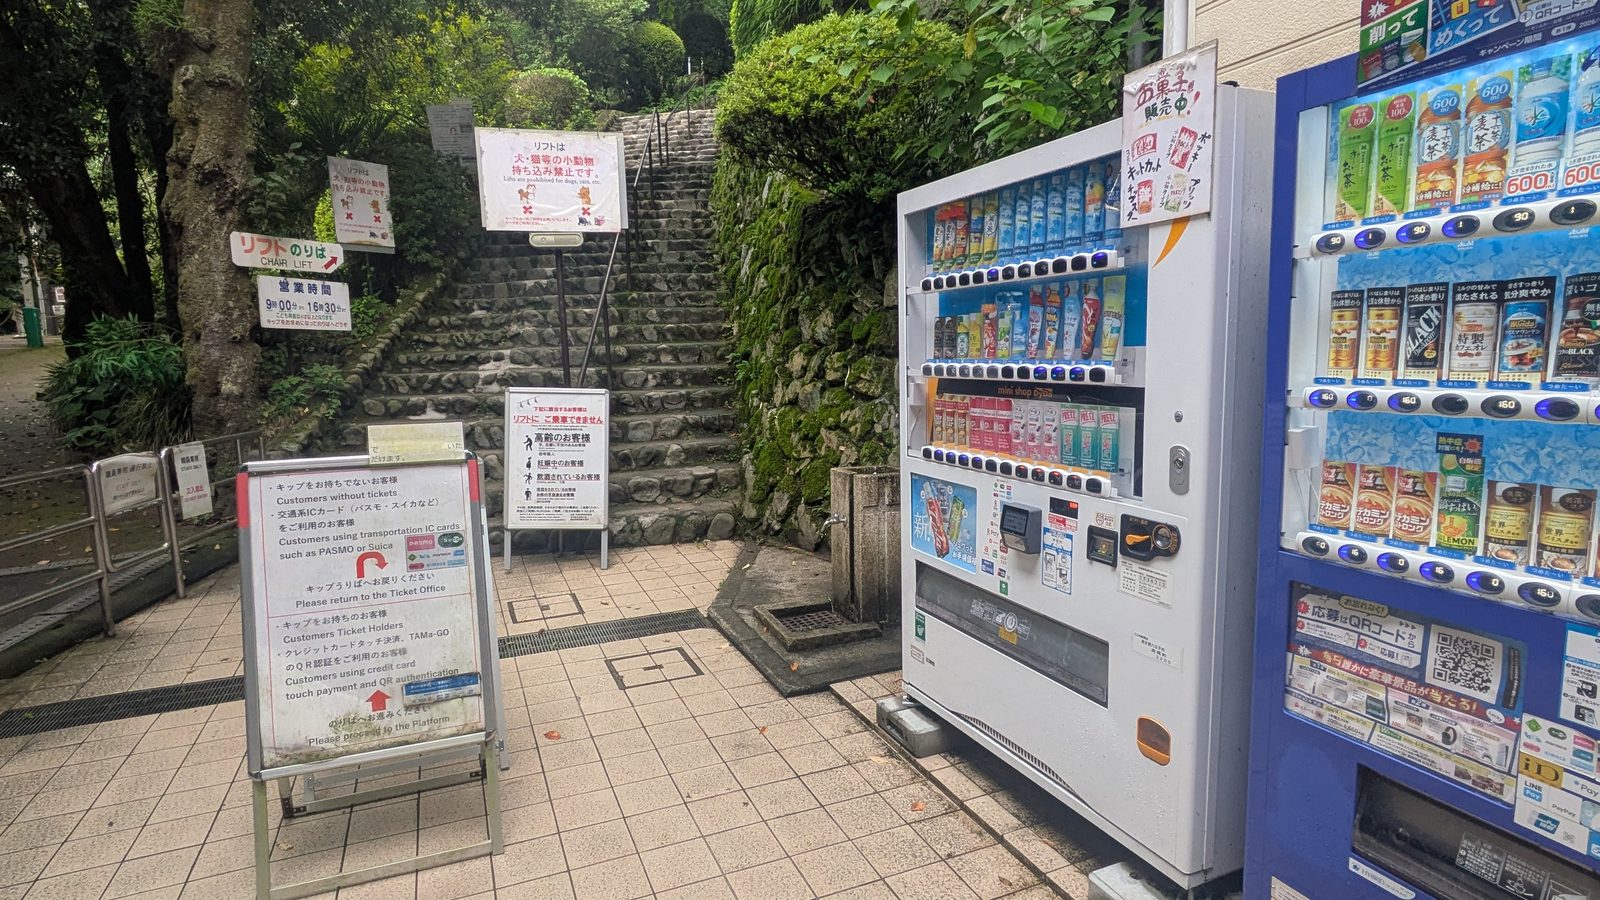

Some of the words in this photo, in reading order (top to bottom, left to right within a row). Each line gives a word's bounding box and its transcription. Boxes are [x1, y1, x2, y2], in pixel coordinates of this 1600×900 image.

[1369, 8, 1419, 46] 削って
[1435, 4, 1504, 47] めくって
[1479, 32, 1543, 57] キャンペーン期間
[1482, 83, 1508, 98] 600
[1432, 96, 1458, 110] 600
[1474, 115, 1492, 150] 麦茶
[533, 142, 566, 152] リフトは
[1426, 126, 1442, 160] 麦茶
[514, 153, 594, 166] 犬・猫等の小動物
[1187, 132, 1212, 172] ポッキー
[511, 165, 599, 179] 持ち込み禁止です。
[1128, 158, 1162, 180] キットカット
[1506, 173, 1549, 195] 600
[1183, 179, 1201, 209] プリッツ
[241, 235, 327, 259] リフトのりば
[260, 256, 288, 267] CHAIR
[293, 260, 313, 269] LIFT
[278, 279, 332, 296] 営業時間
[1504, 288, 1551, 300] 気分爽やか
[1455, 291, 1498, 301] 満たされる
[1510, 320, 1535, 329] Wonda
[1406, 305, 1442, 360] BLACK
[1458, 333, 1484, 344] 特製
[1455, 344, 1487, 352] カフェオレ
[997, 386, 1013, 396] mini
[1014, 386, 1032, 397] shop
[513, 415, 540, 424] リフトに
[544, 415, 604, 424] ご乗車できません
[1062, 410, 1076, 420] PRETZ
[1080, 410, 1096, 421] PRETZ
[1100, 413, 1116, 423] PRETZ
[534, 433, 591, 443] 高齢のお客様
[370, 454, 406, 464] だけます。
[536, 473, 600, 481] 飲酒されているお客様
[276, 494, 328, 506] Customers
[330, 491, 365, 502] without
[367, 488, 398, 499] tickets
[278, 518, 355, 533] をご利用のお客様
[278, 534, 330, 547] Customers
[332, 531, 358, 544] using
[360, 525, 423, 539] transportation
[424, 523, 435, 533] IC
[436, 522, 460, 532] cards
[1442, 537, 1475, 546] LEMON
[279, 549, 303, 560] such
[305, 549, 316, 558] as
[318, 545, 354, 556] PASMO
[368, 541, 394, 551] Suica
[306, 572, 436, 594] キップうりばへお戻りください
[295, 597, 328, 609] Please
[330, 594, 359, 606] return
[361, 593, 370, 602] to
[372, 590, 388, 600] the
[389, 587, 418, 598] Ticket
[419, 584, 446, 595] Office
[283, 632, 335, 644] Customers
[337, 627, 367, 638] Ticket
[369, 621, 404, 633] Holders
[408, 628, 450, 640] TAMa-GO
[285, 674, 337, 686] Customers
[339, 669, 365, 681] using
[367, 663, 394, 675] credit
[396, 660, 416, 670] card
[1323, 650, 1478, 711] 毎日誰かに豪華景品が当たる!
[285, 689, 315, 701] touch
[316, 683, 358, 697] payment
[359, 678, 377, 690] and
[379, 676, 393, 687] QR
[395, 667, 459, 684] authentication
[308, 735, 341, 747] Please
[343, 726, 381, 740] proceed
[382, 724, 393, 734] to
[395, 721, 410, 731] the
[412, 714, 450, 728] Platform
[1524, 757, 1560, 782] iD
[1524, 780, 1543, 792] LINE
[1580, 783, 1599, 798] Pay
[1525, 789, 1541, 799] Pay
[1551, 803, 1577, 817] PayPay
